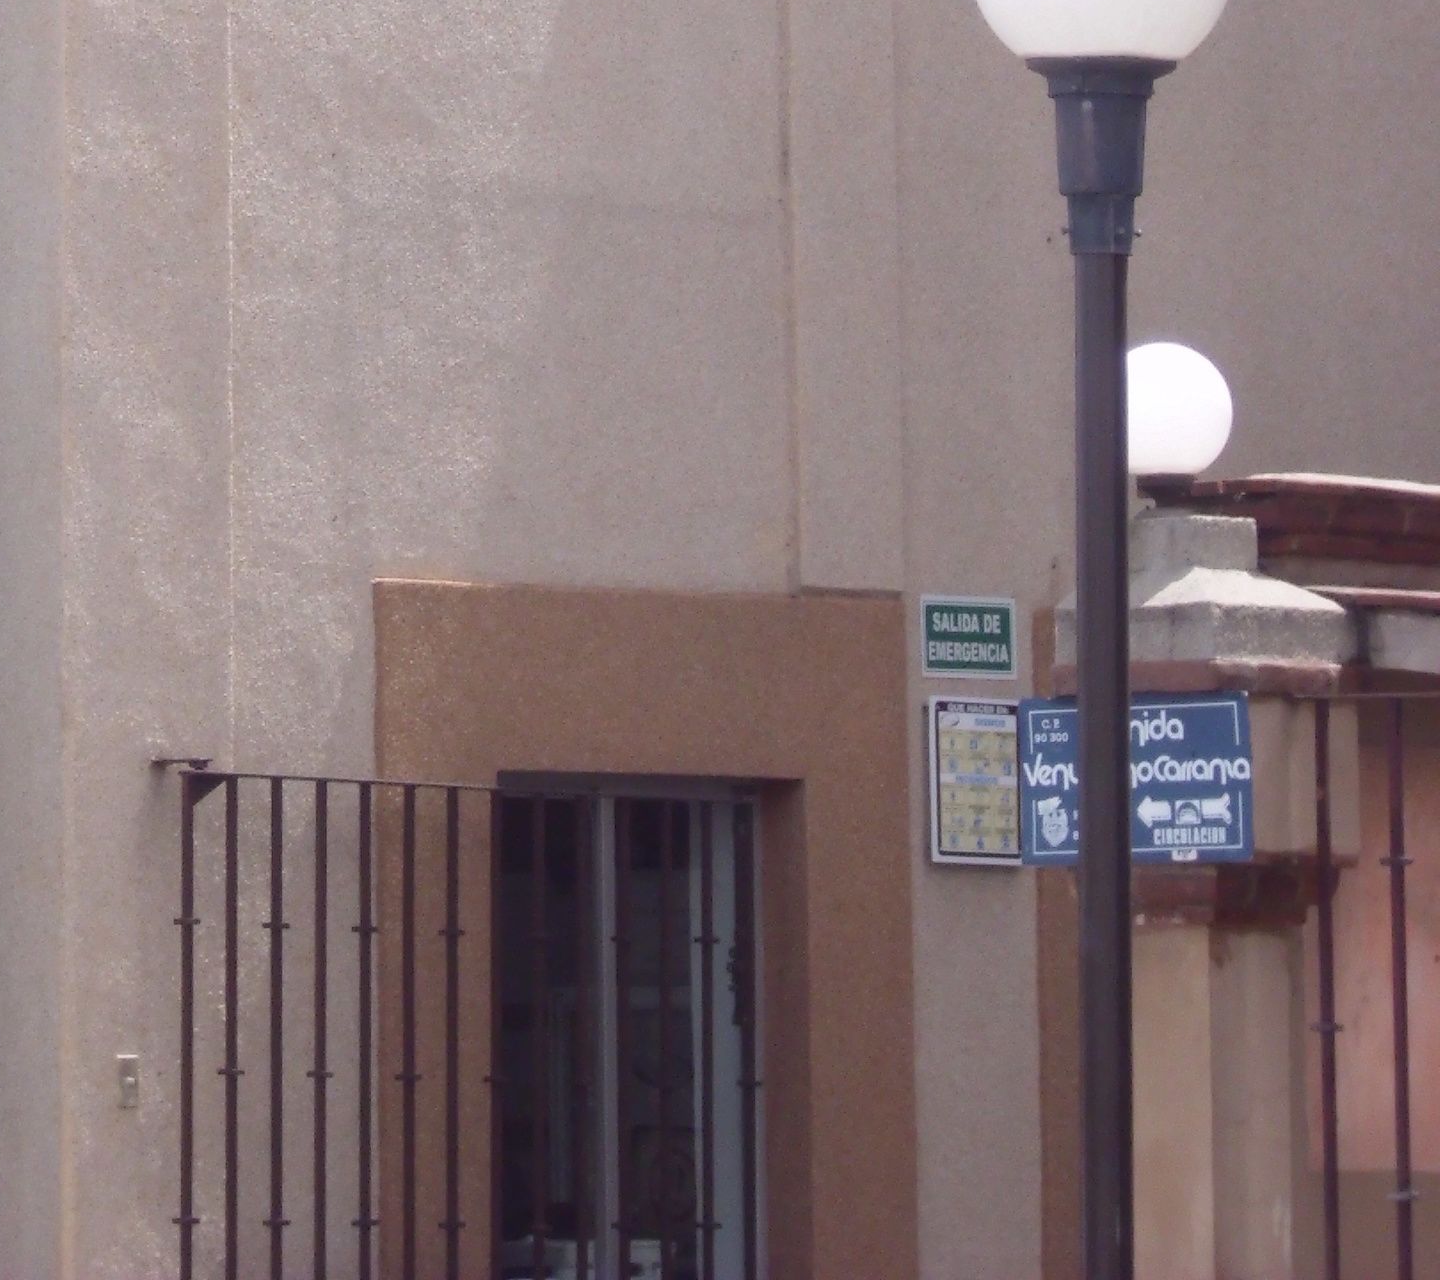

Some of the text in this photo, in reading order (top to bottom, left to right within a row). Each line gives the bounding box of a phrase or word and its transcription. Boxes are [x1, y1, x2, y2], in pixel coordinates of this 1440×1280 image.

[932, 611, 1002, 634] SALIDA DE
[928, 641, 1010, 663] EMERGENCIA
[1130, 709, 1185, 747] nida
[1153, 826, 1228, 845] CIRCULACION
